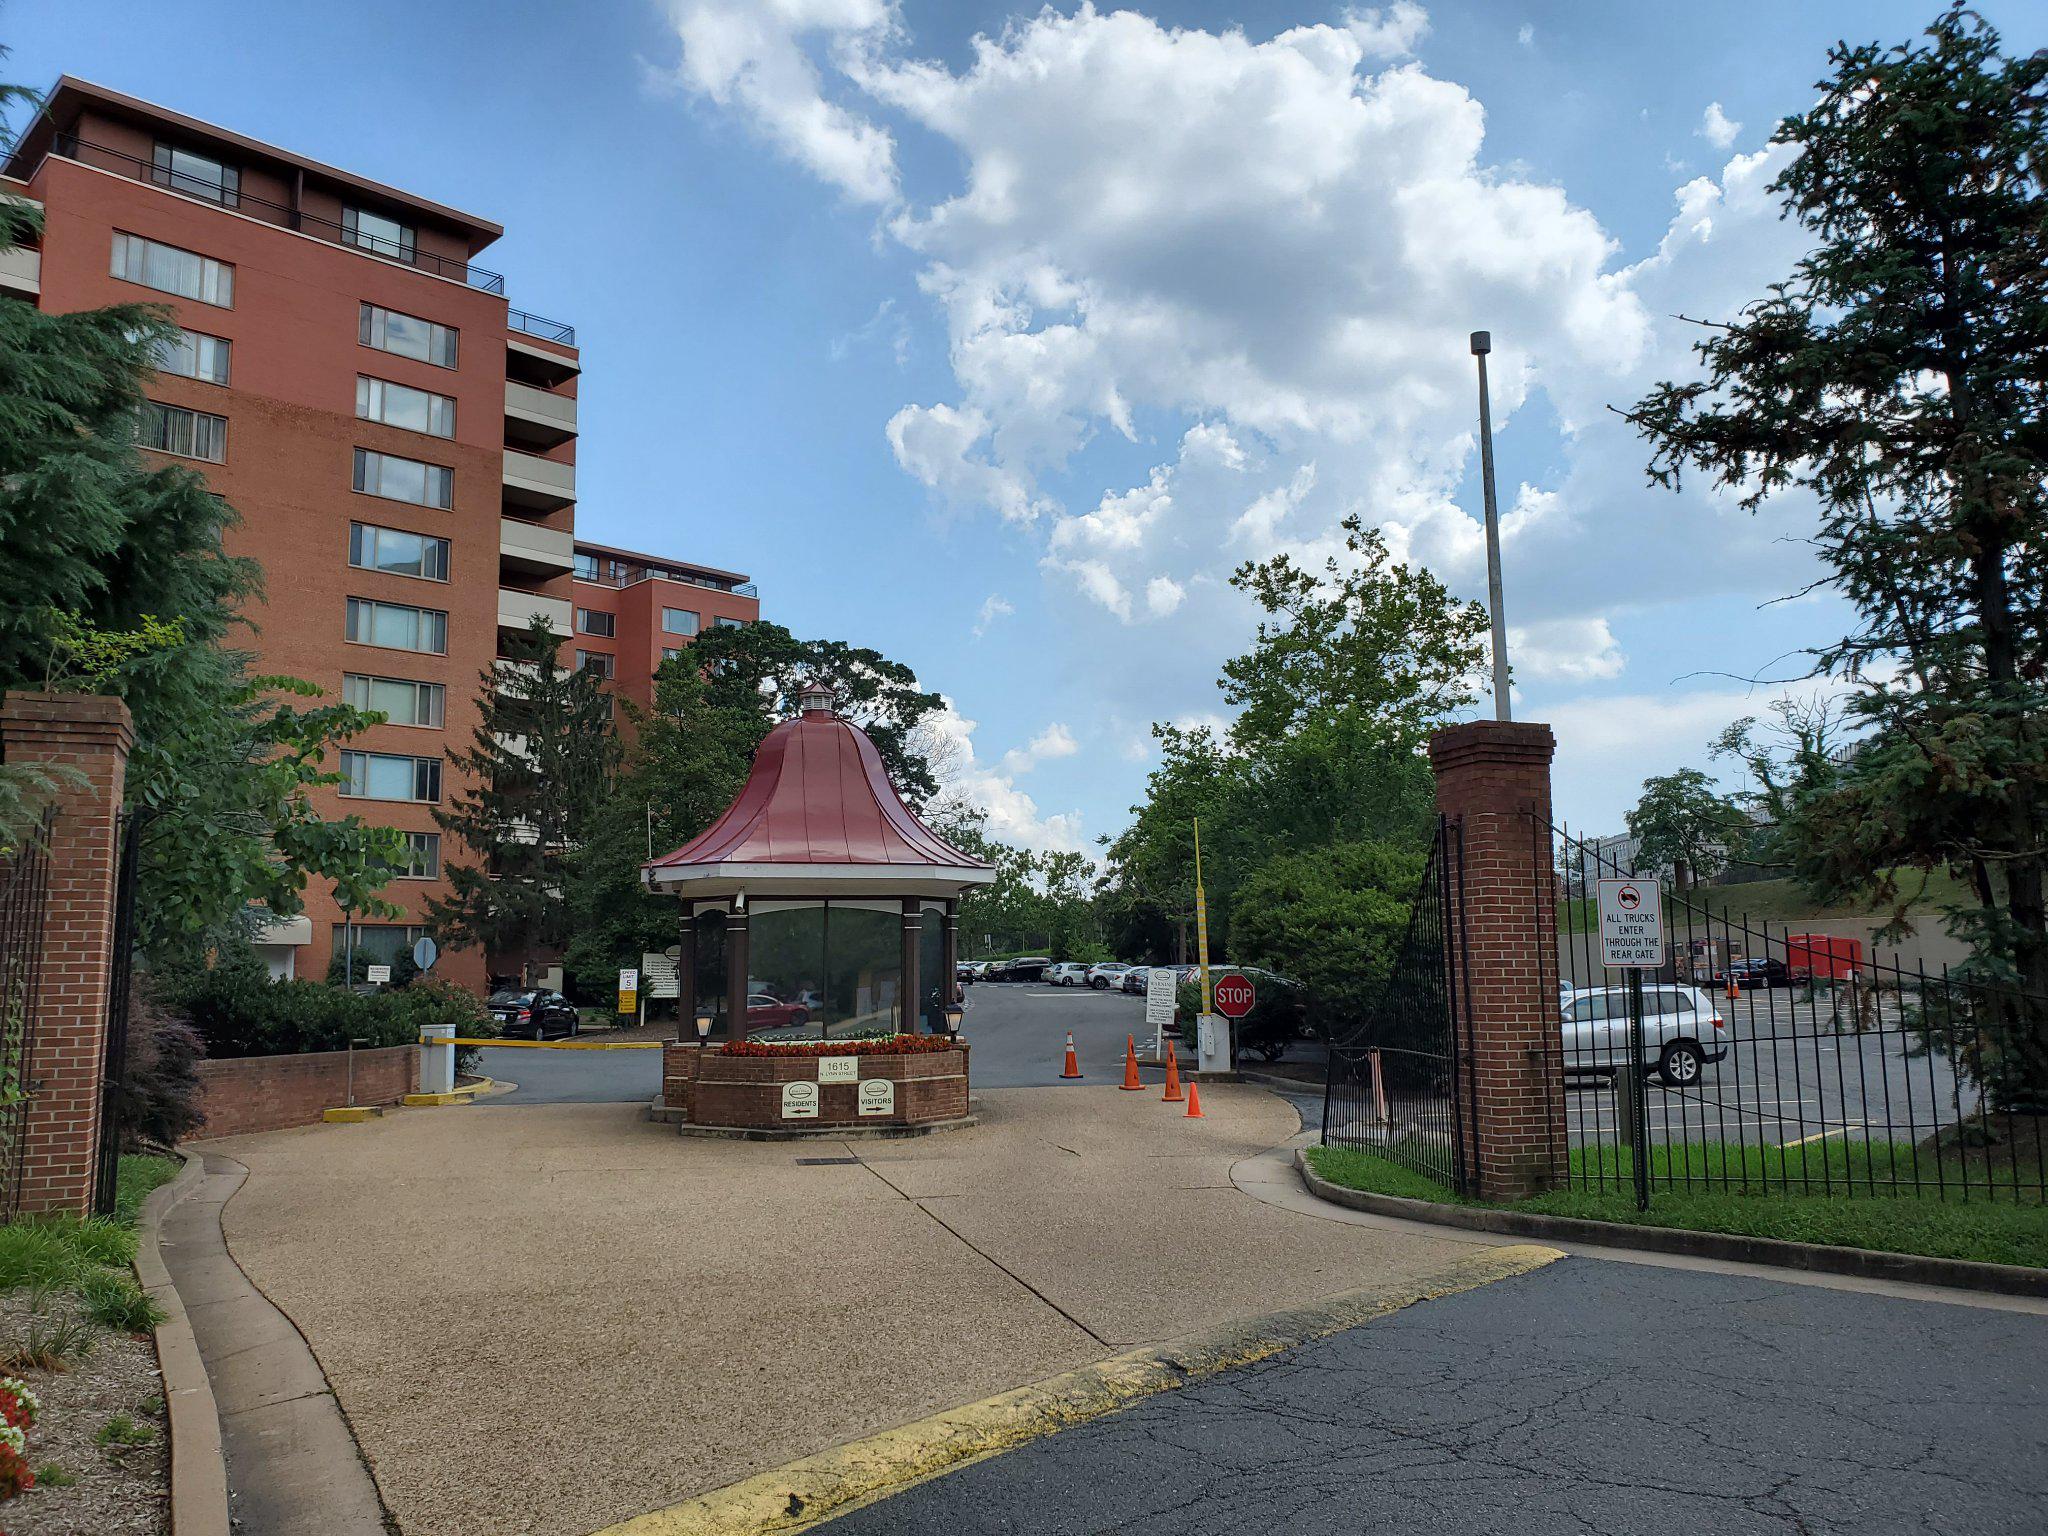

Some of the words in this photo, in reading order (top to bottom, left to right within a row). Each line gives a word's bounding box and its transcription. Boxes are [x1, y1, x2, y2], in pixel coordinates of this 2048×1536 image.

[1606, 914, 1621, 922] ALL
[1625, 914, 1655, 922] TRUCKS
[1619, 926, 1644, 934] ENTER
[1605, 938, 1641, 947] THROUGH
[1644, 938, 1659, 946] THE
[1611, 950, 1632, 959] REAR
[1635, 950, 1655, 959] GATE
[1218, 988, 1252, 1004] STOP
[827, 1062, 849, 1071] 1615
[783, 1100, 817, 1108] RESIDENTS
[860, 1097, 892, 1106] VISITORS
